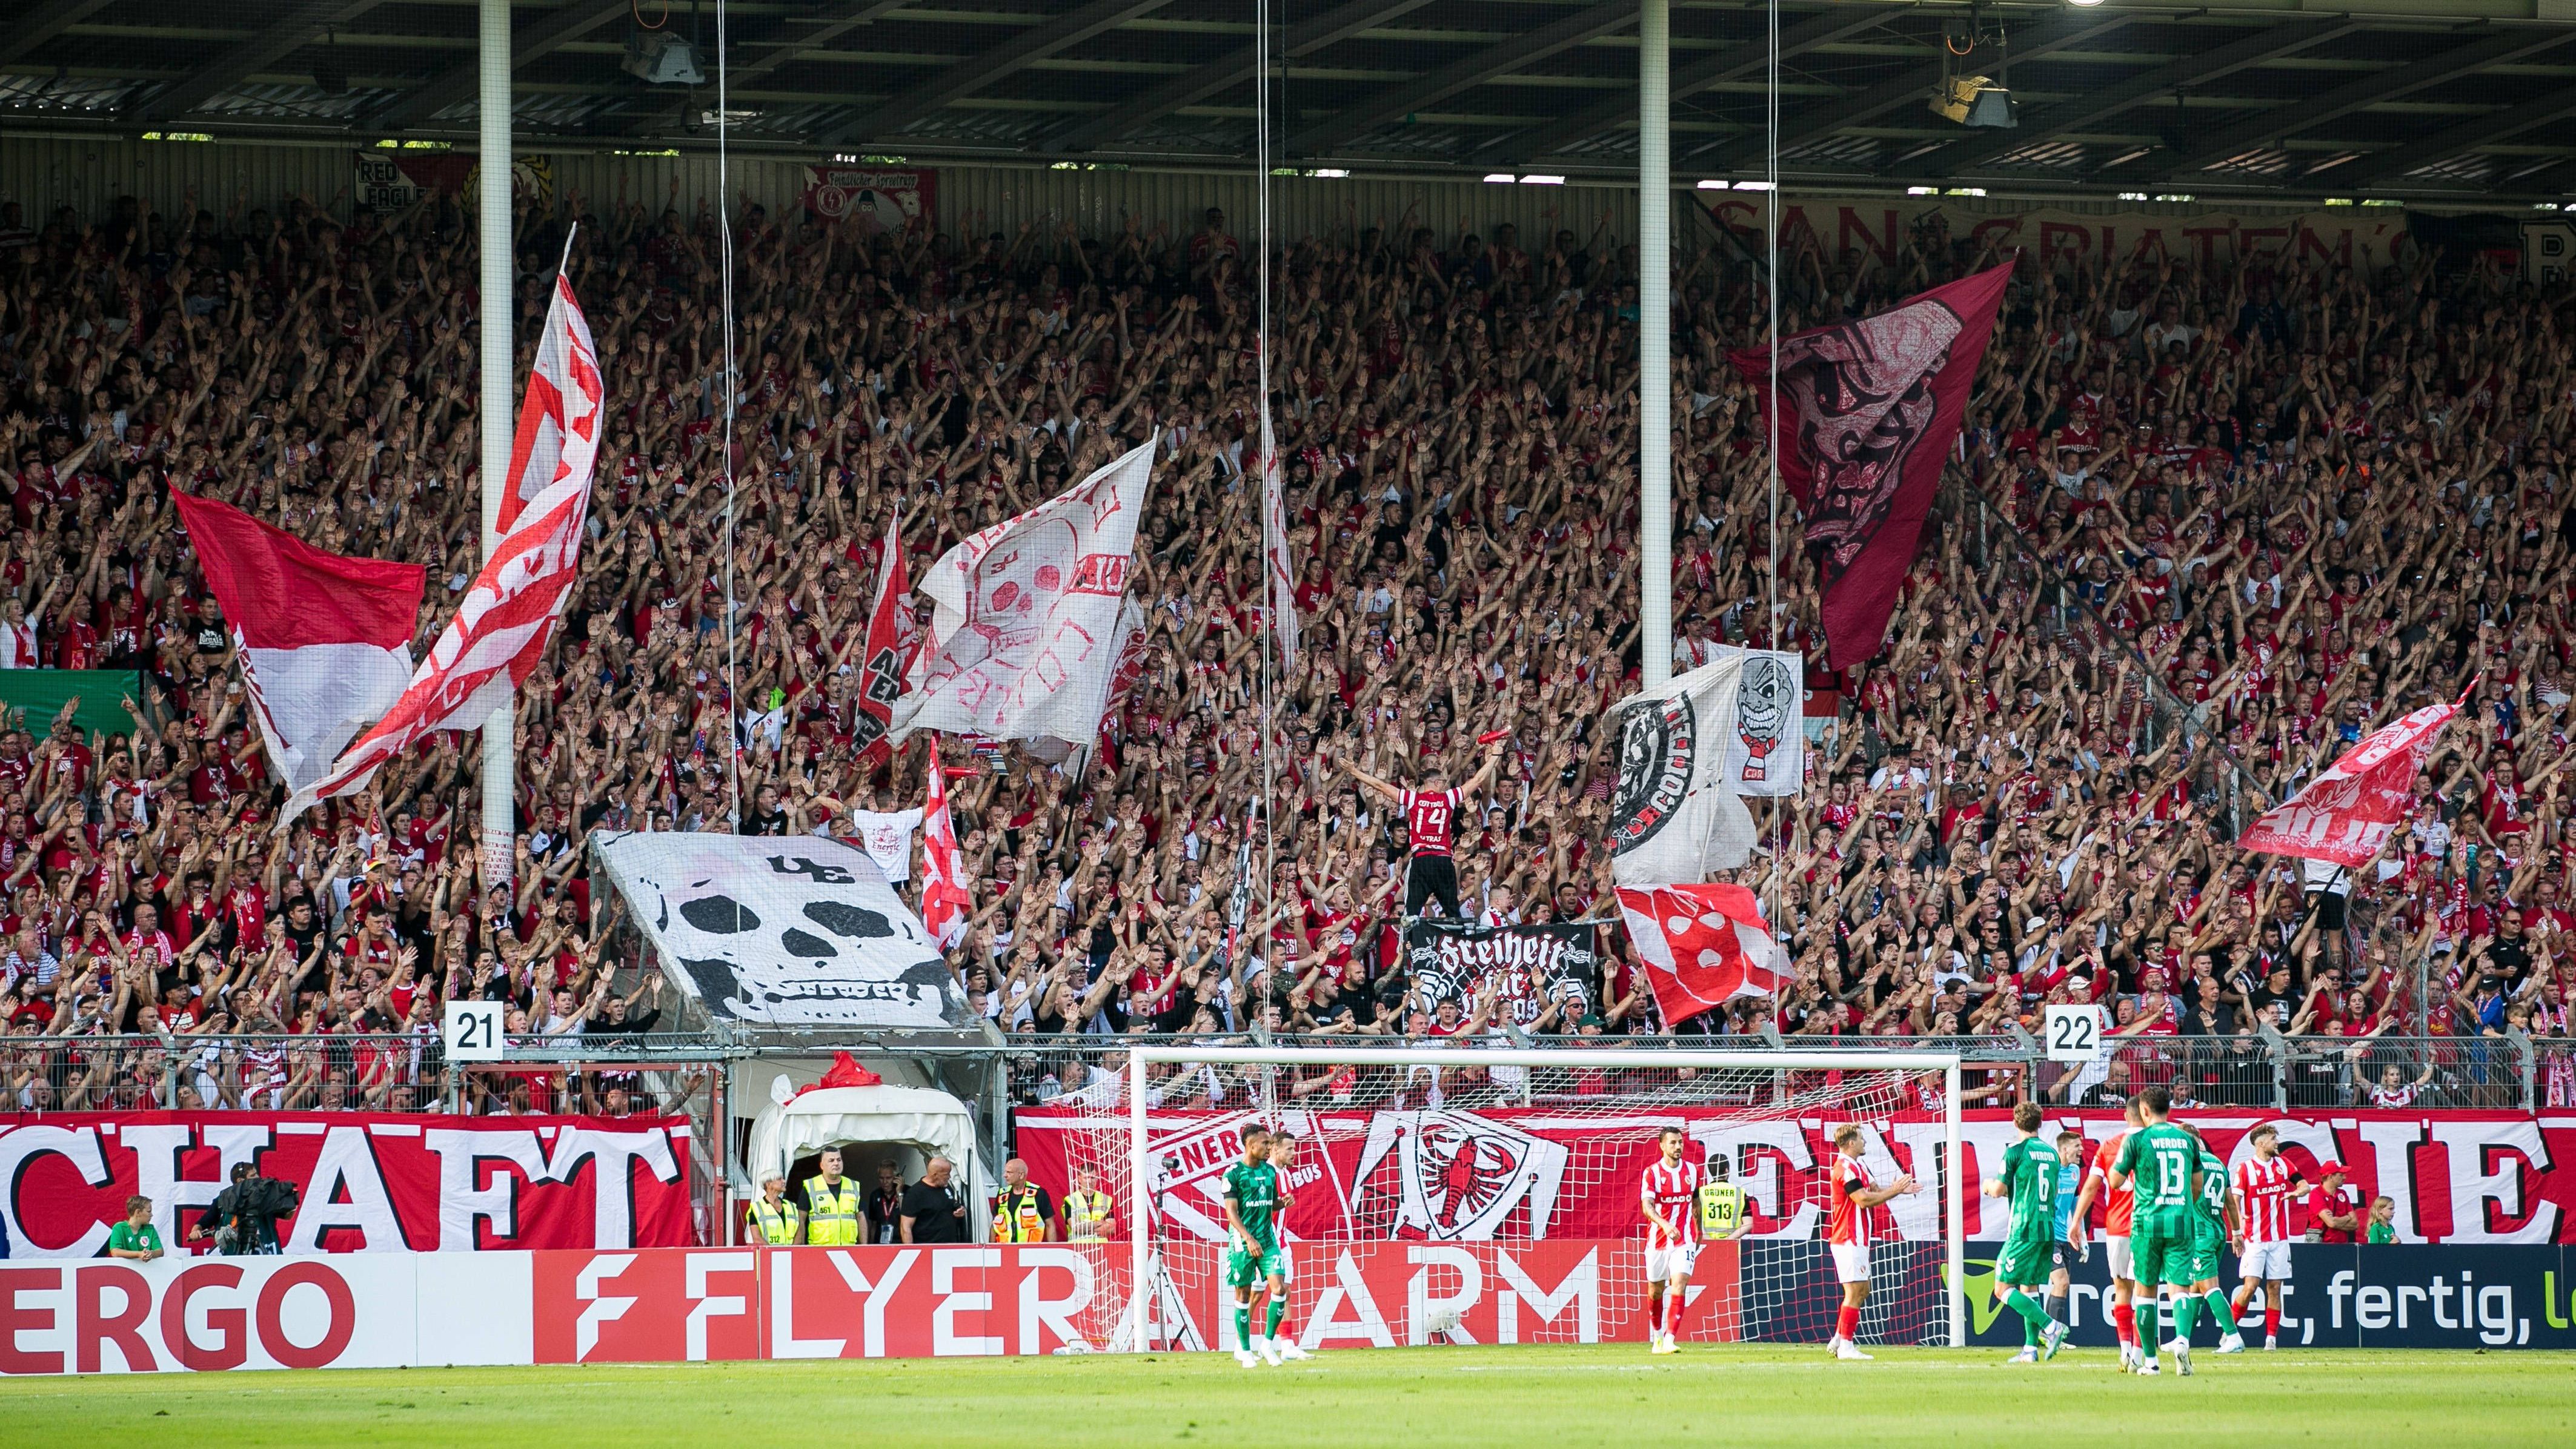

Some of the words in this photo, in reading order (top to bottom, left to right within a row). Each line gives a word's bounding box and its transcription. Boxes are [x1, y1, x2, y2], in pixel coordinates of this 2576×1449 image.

[359, 160, 399, 182] RED
[1416, 807, 1447, 834] 14
[1439, 931, 1564, 975] Freiheit
[457, 1012, 494, 1049] 21
[2054, 1016, 2094, 1050] 22
[2028, 1150, 2056, 1162] WERDER
[2151, 1138, 2188, 1150] WERDER
[2037, 1162, 2050, 1202] 6
[2156, 1150, 2185, 1196] 13
[2201, 1162, 2224, 1173] WERDER
[2203, 1172, 2225, 1208] 42
[1708, 1202, 1731, 1220] 313
[1686, 1250, 1695, 1263] 19
[0, 1261, 356, 1373] ERGO
[2328, 1270, 2529, 1344] fertig,
[2544, 1270, 2576, 1330] l
